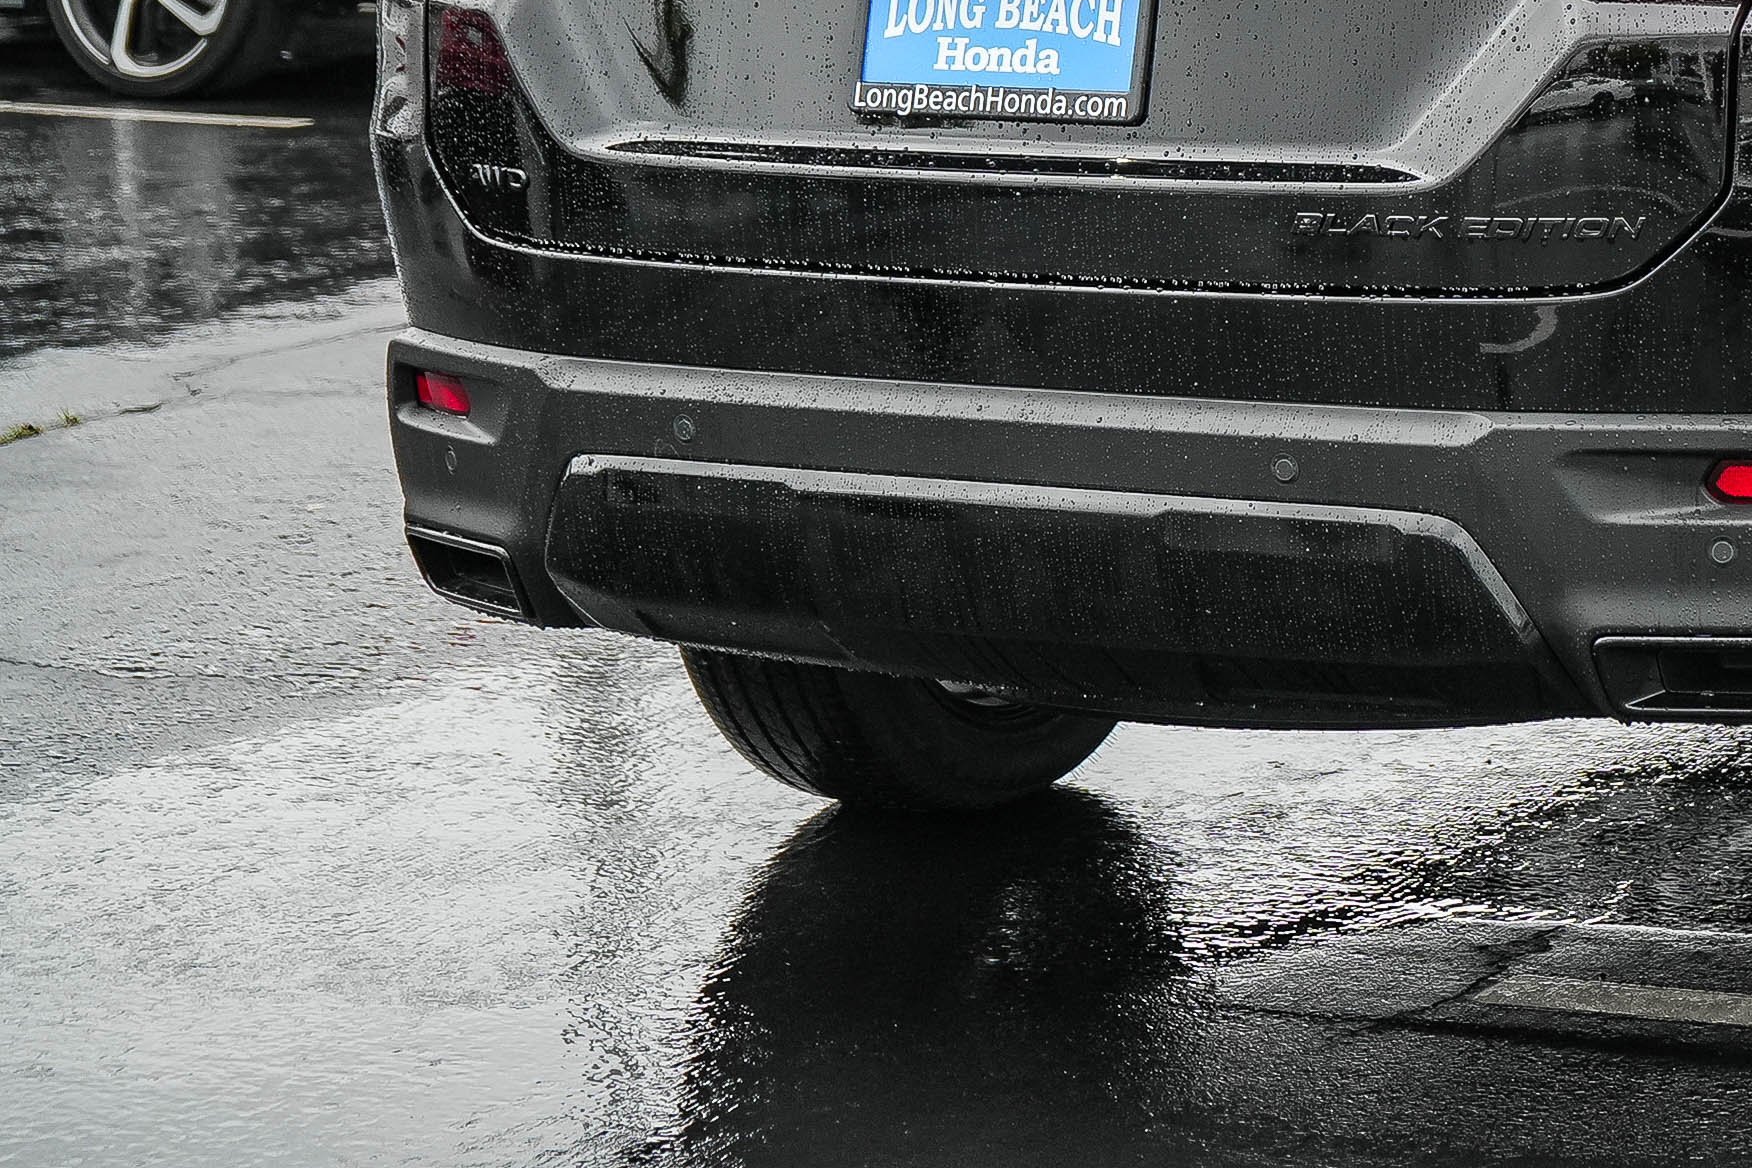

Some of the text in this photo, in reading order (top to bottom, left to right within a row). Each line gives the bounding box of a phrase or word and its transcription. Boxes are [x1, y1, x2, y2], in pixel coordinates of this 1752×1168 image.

[933, 37, 1061, 75] Honda
[853, 82, 1127, 117] LongBeachHonda.com
[1292, 212, 1645, 241] BLACK EDITION
